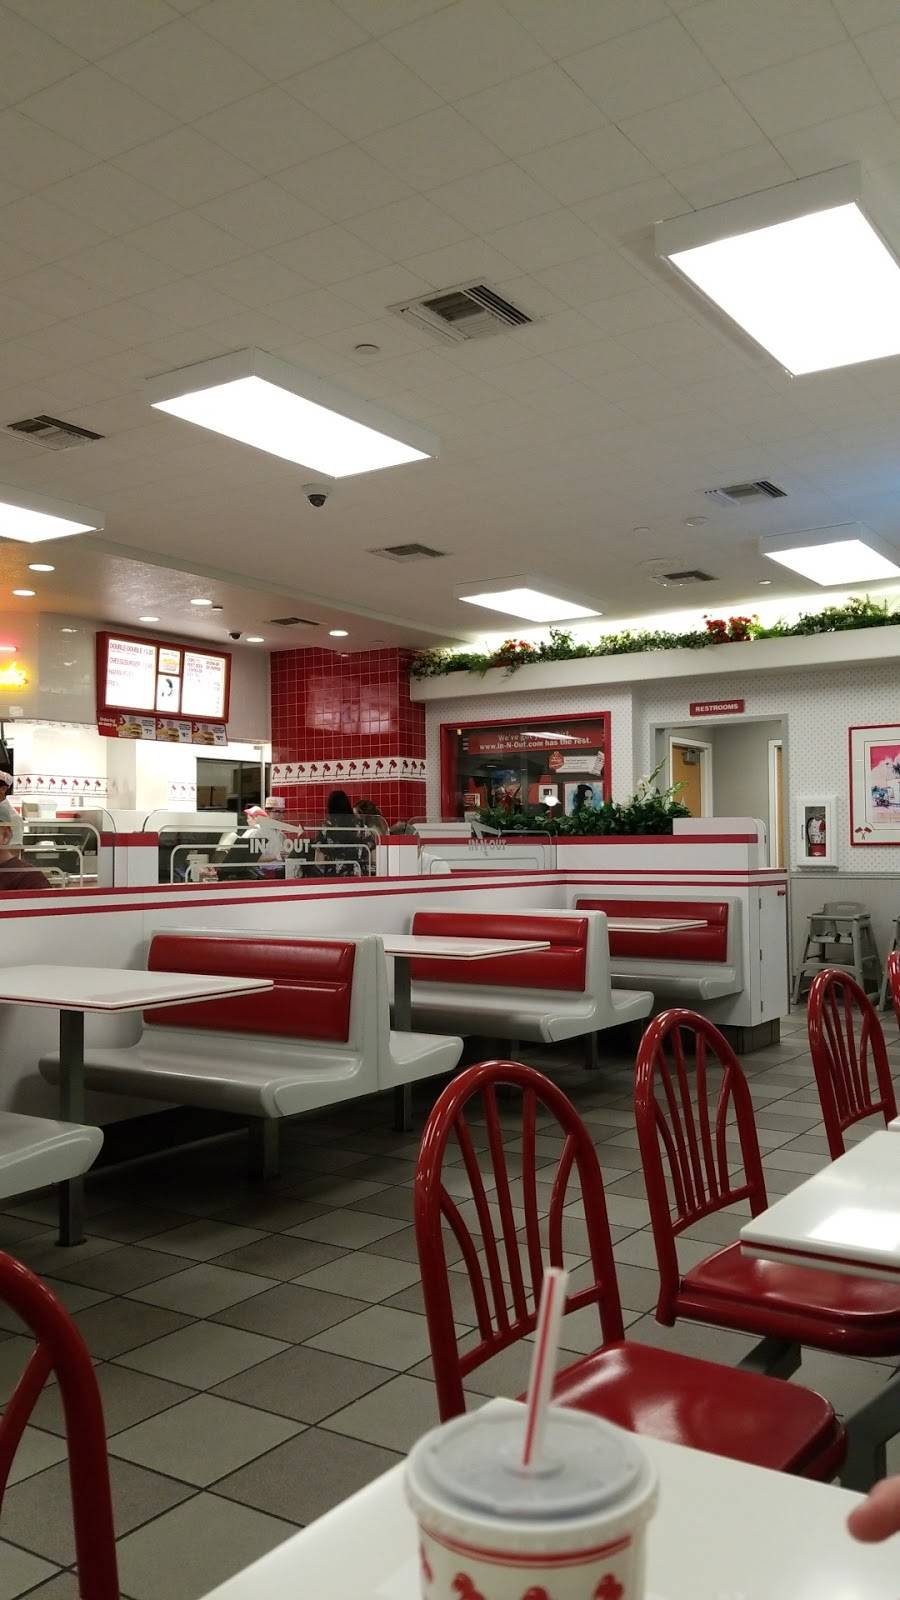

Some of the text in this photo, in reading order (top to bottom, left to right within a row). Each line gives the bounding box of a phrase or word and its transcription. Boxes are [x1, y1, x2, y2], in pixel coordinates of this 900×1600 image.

[695, 703, 739, 713] RESTROOMS
[497, 734, 518, 742] We've
[544, 738, 559, 747] has
[559, 737, 572, 746] the
[573, 735, 592, 745] rest.
